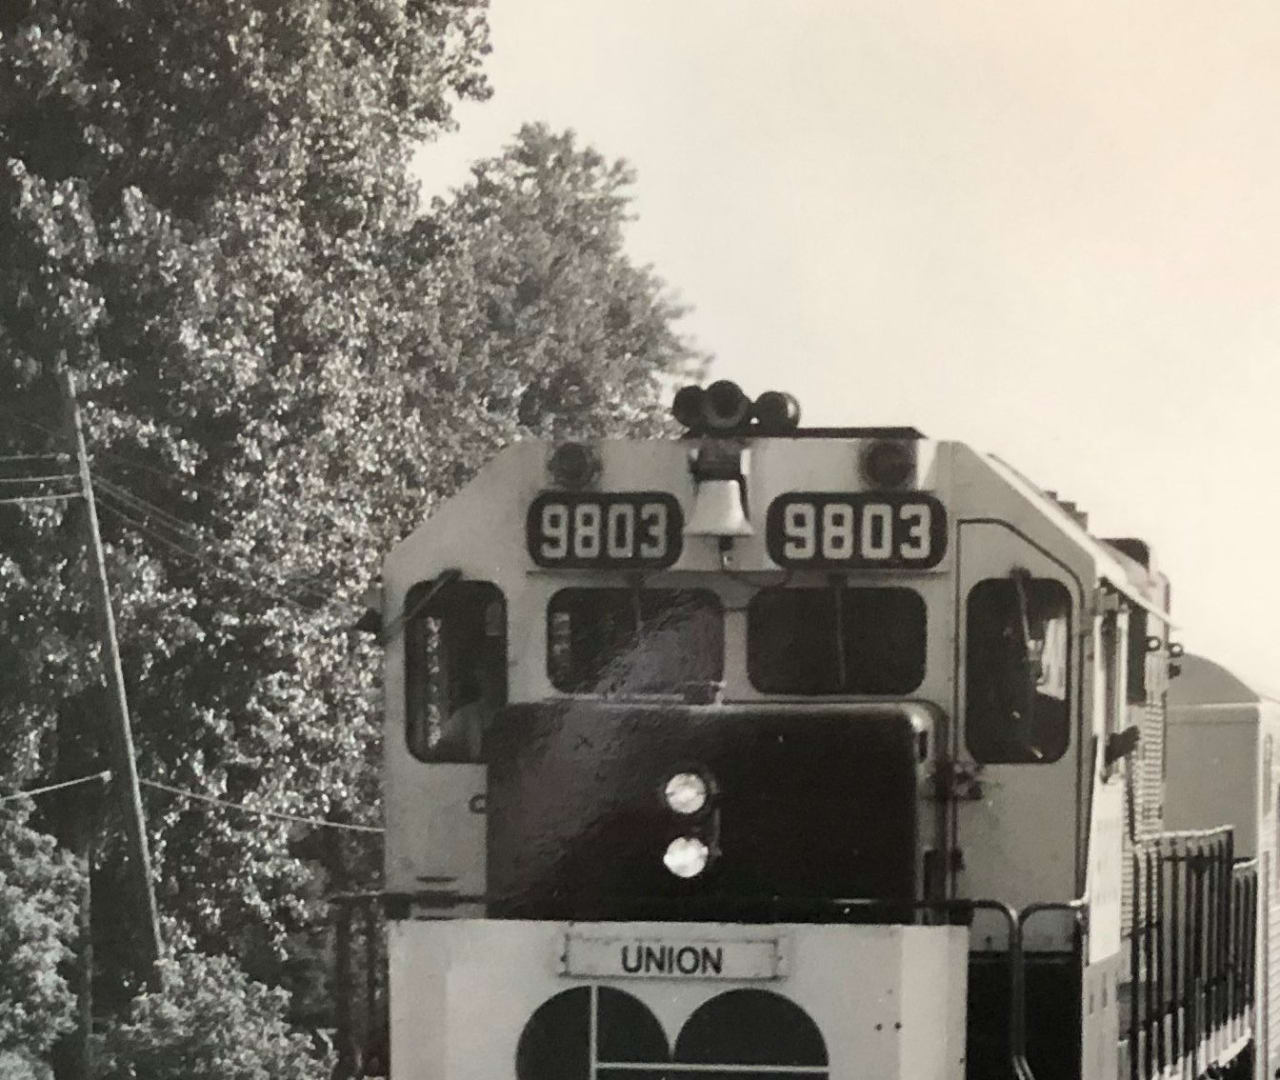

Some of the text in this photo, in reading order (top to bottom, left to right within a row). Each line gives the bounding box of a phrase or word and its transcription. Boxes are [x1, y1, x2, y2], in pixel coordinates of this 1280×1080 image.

[541, 503, 668, 559] 9803
[784, 503, 932, 559] 9803
[621, 945, 723, 974] UNION
